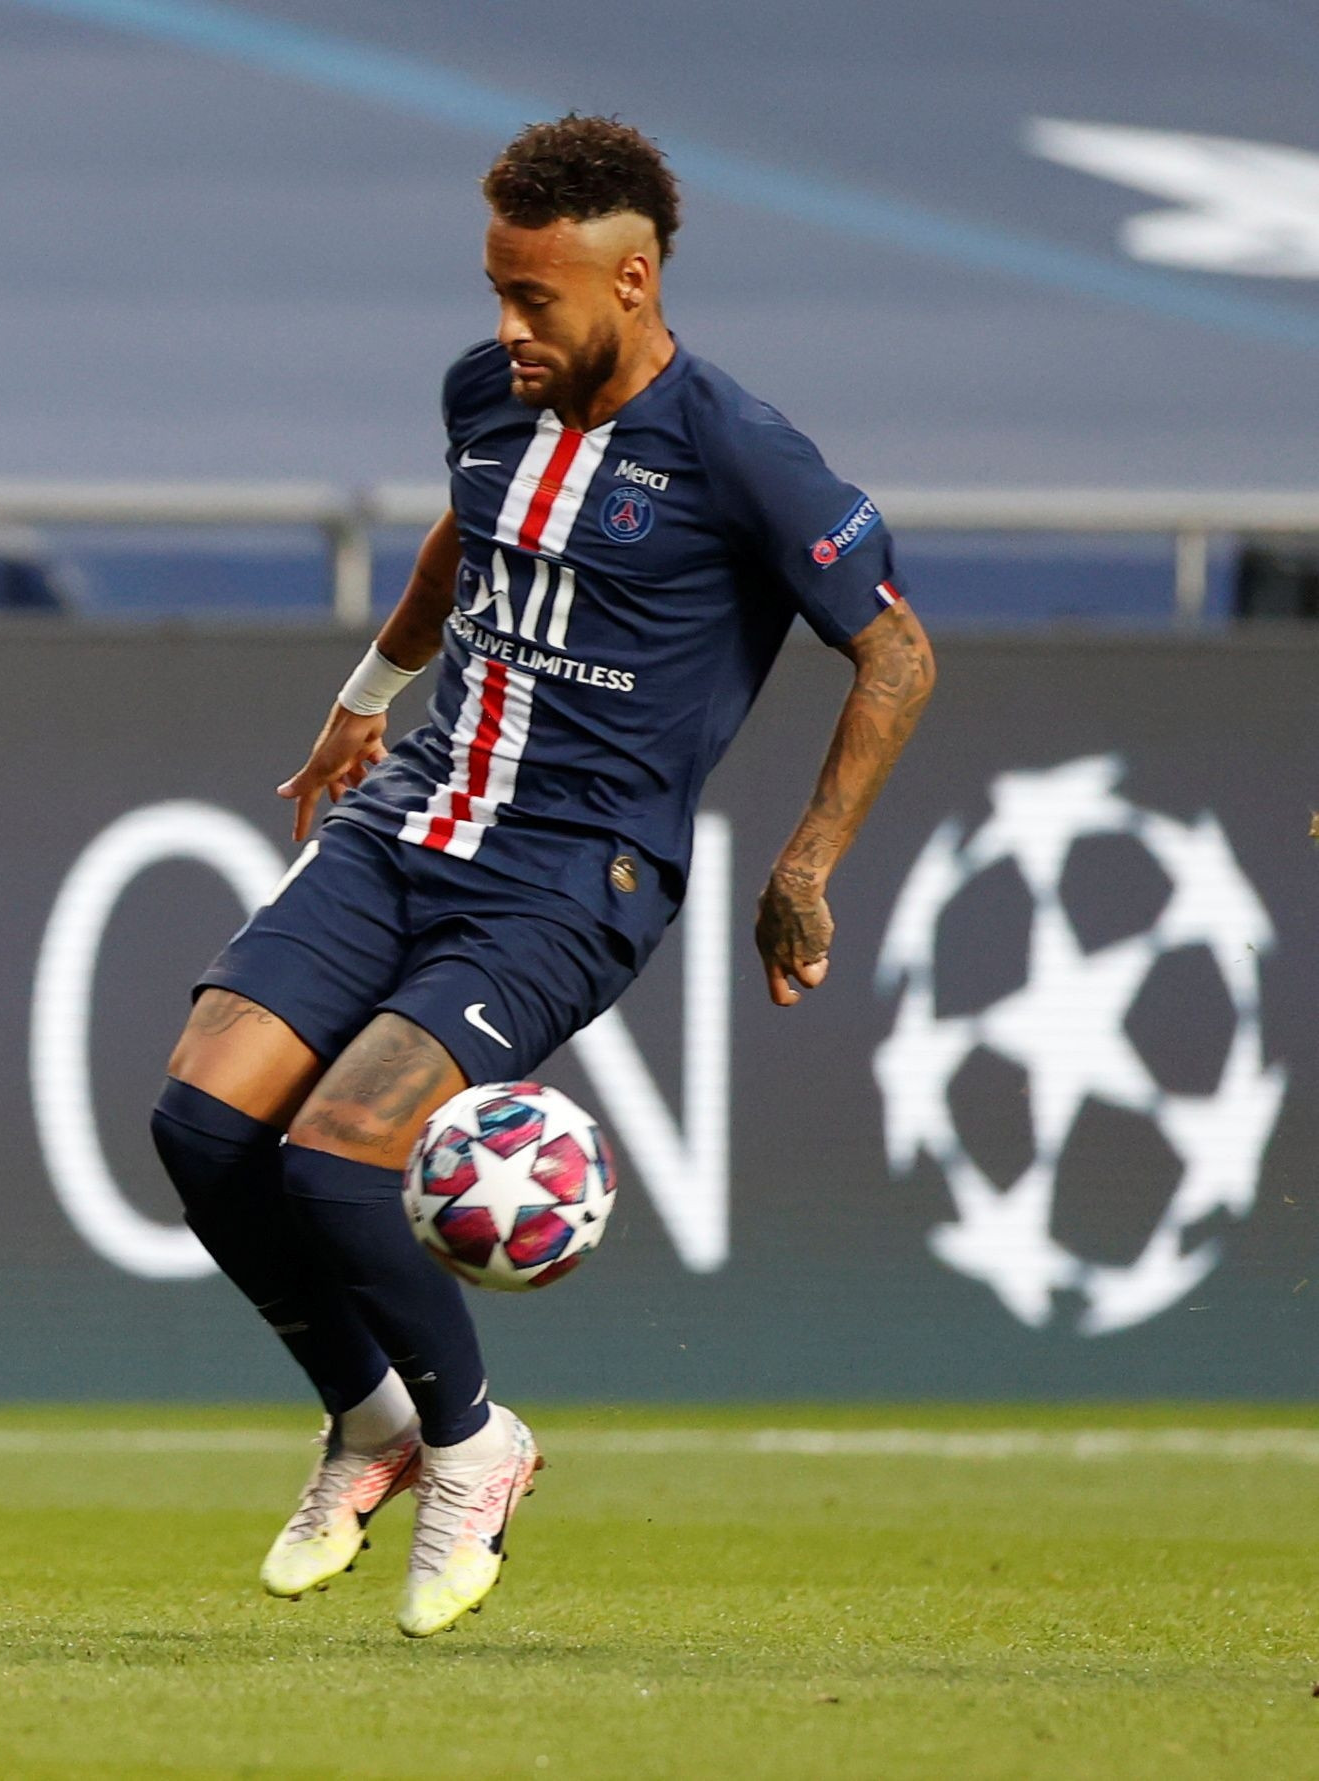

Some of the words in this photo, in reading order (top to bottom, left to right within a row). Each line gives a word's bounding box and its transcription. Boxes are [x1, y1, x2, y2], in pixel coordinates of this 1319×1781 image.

[614, 459, 670, 491] Merci
[832, 500, 875, 548] RESPECT
[475, 628, 515, 661] LIVE
[517, 646, 636, 692] LIMITLESS
